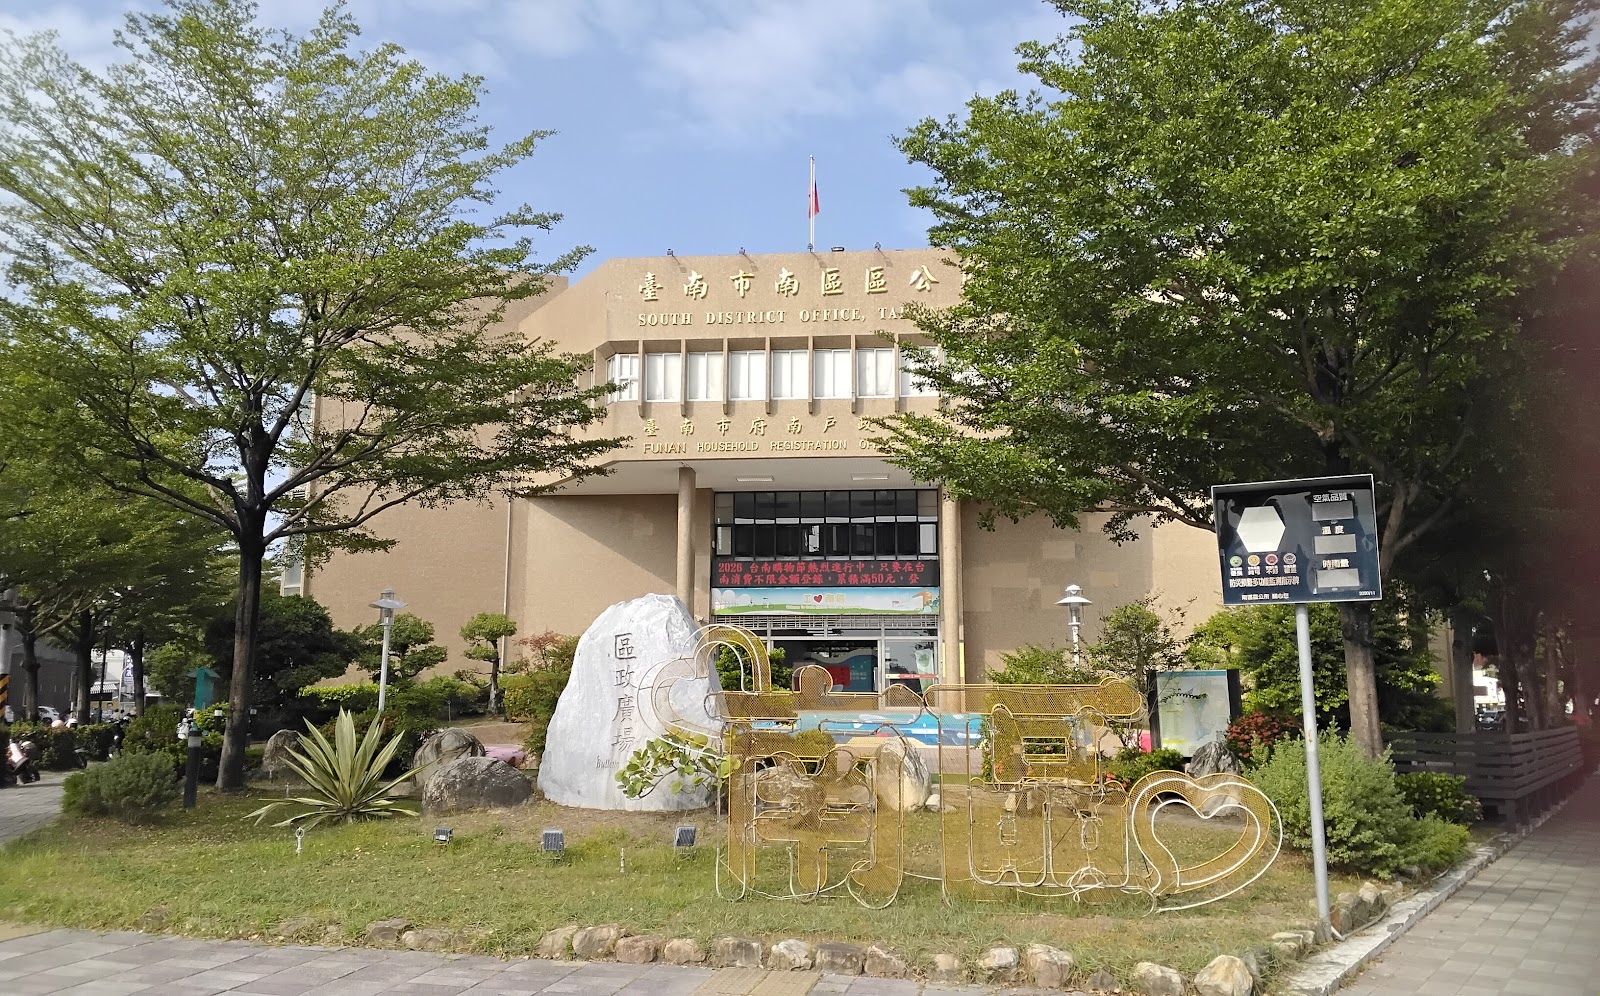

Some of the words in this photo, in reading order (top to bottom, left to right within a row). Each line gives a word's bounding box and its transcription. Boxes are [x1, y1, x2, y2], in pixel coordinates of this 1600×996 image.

[638, 312, 693, 327] SOUTH
[705, 310, 786, 325] DISTRICT
[799, 307, 866, 323] OFFICE,
[643, 413, 950, 437] 臺南市府南戶政
[643, 442, 687, 455] FUNAN
[697, 440, 760, 453] HOUSEHOLD
[770, 438, 848, 452] REGISTRATION
[718, 562, 743, 573] 2026
[611, 632, 638, 753] 區政廣場
